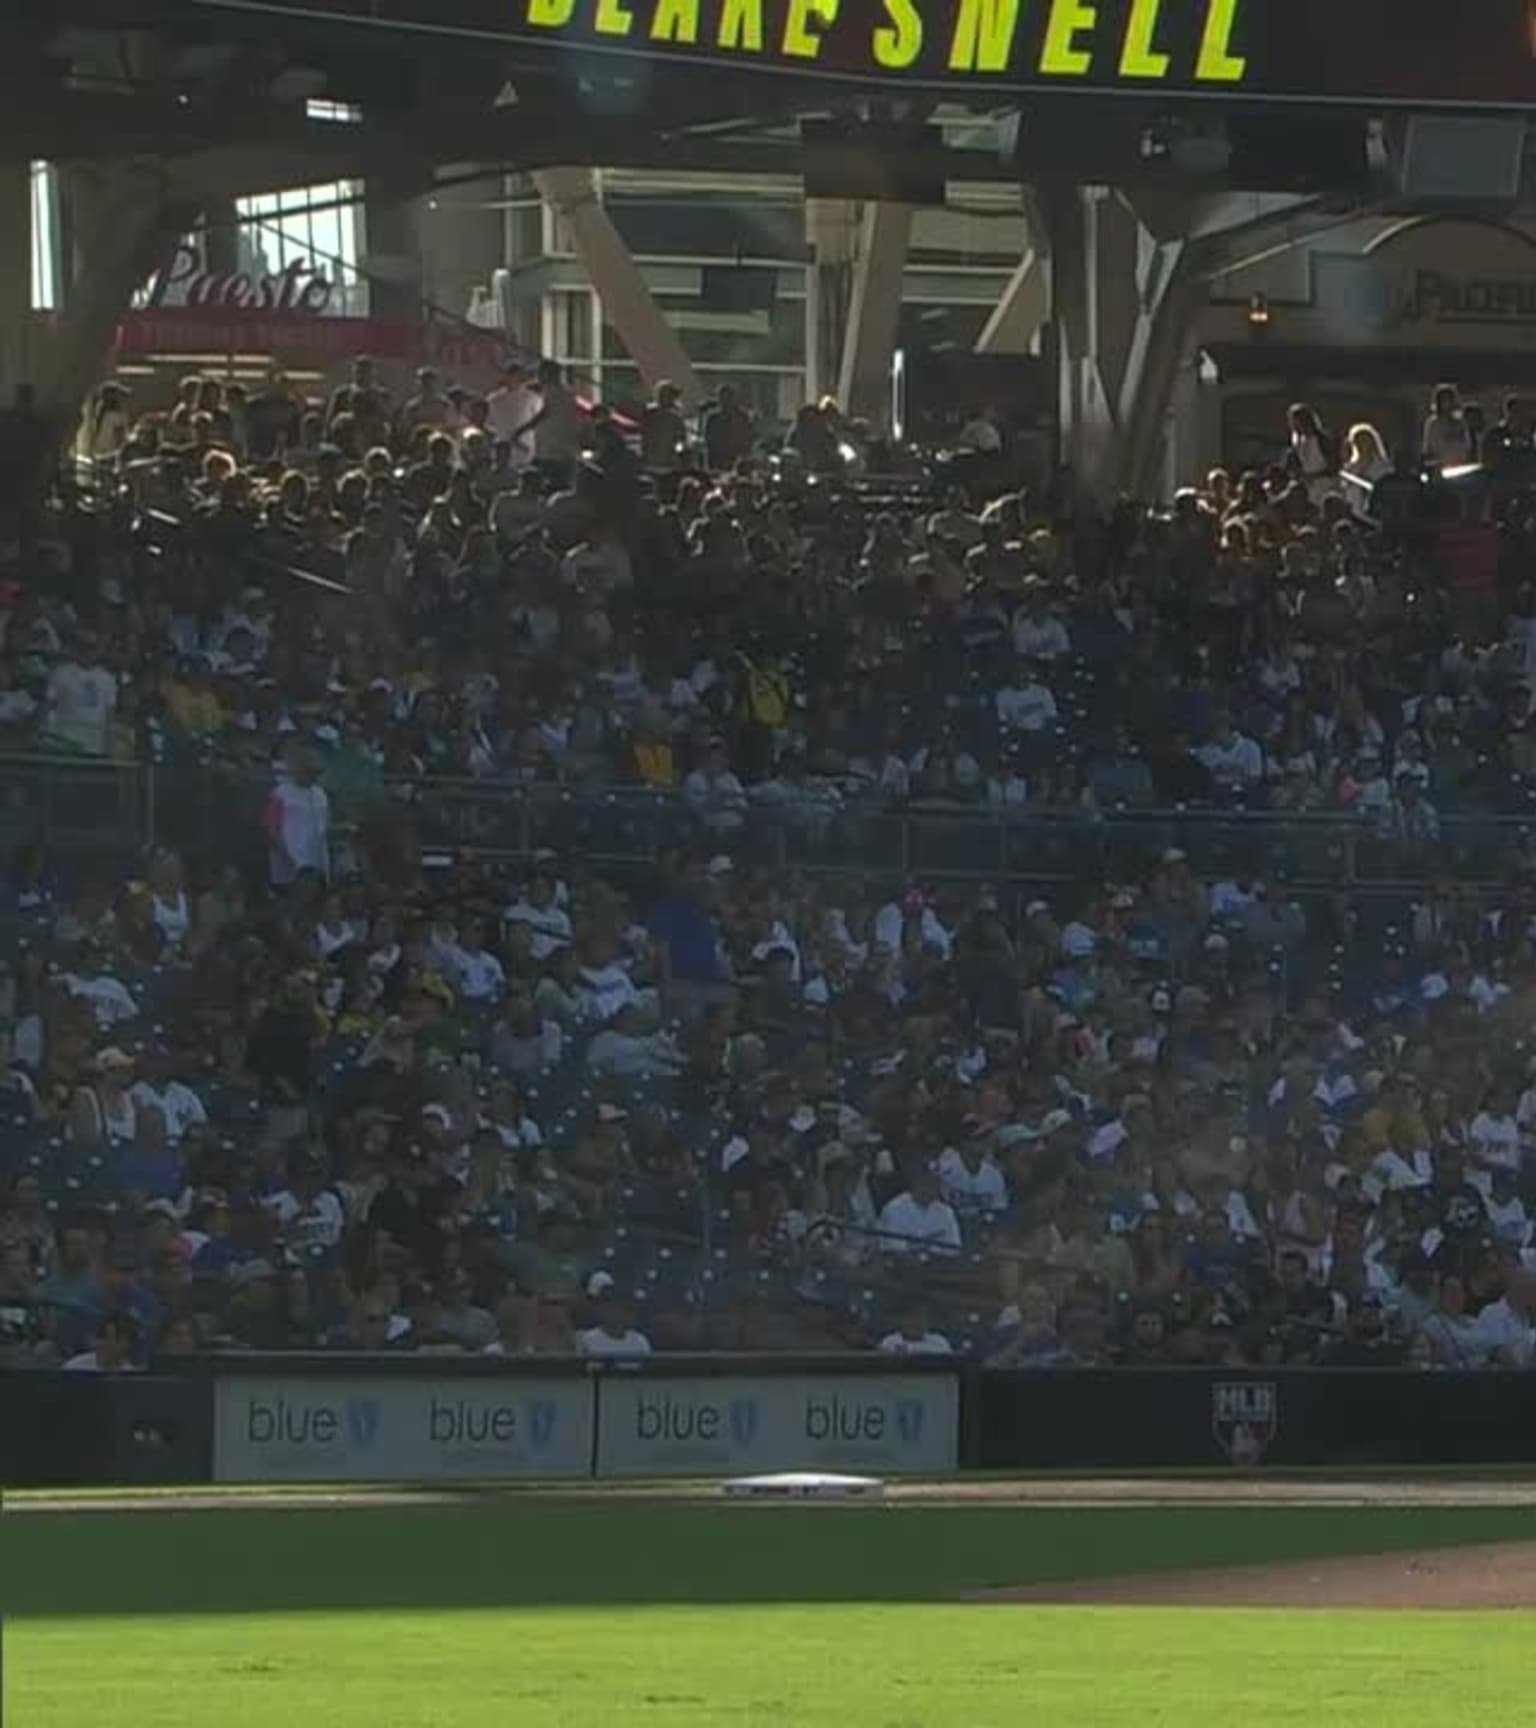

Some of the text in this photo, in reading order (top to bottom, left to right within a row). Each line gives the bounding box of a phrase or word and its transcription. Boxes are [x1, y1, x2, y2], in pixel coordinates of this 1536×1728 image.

[527, 0, 1246, 81] AKE SNELL
[150, 246, 333, 312] Puesto
[249, 1398, 337, 1443] blue
[429, 1397, 516, 1442] blue
[637, 1397, 719, 1441] blue
[806, 1397, 885, 1441] blue
[1212, 1385, 1274, 1421] MLB
